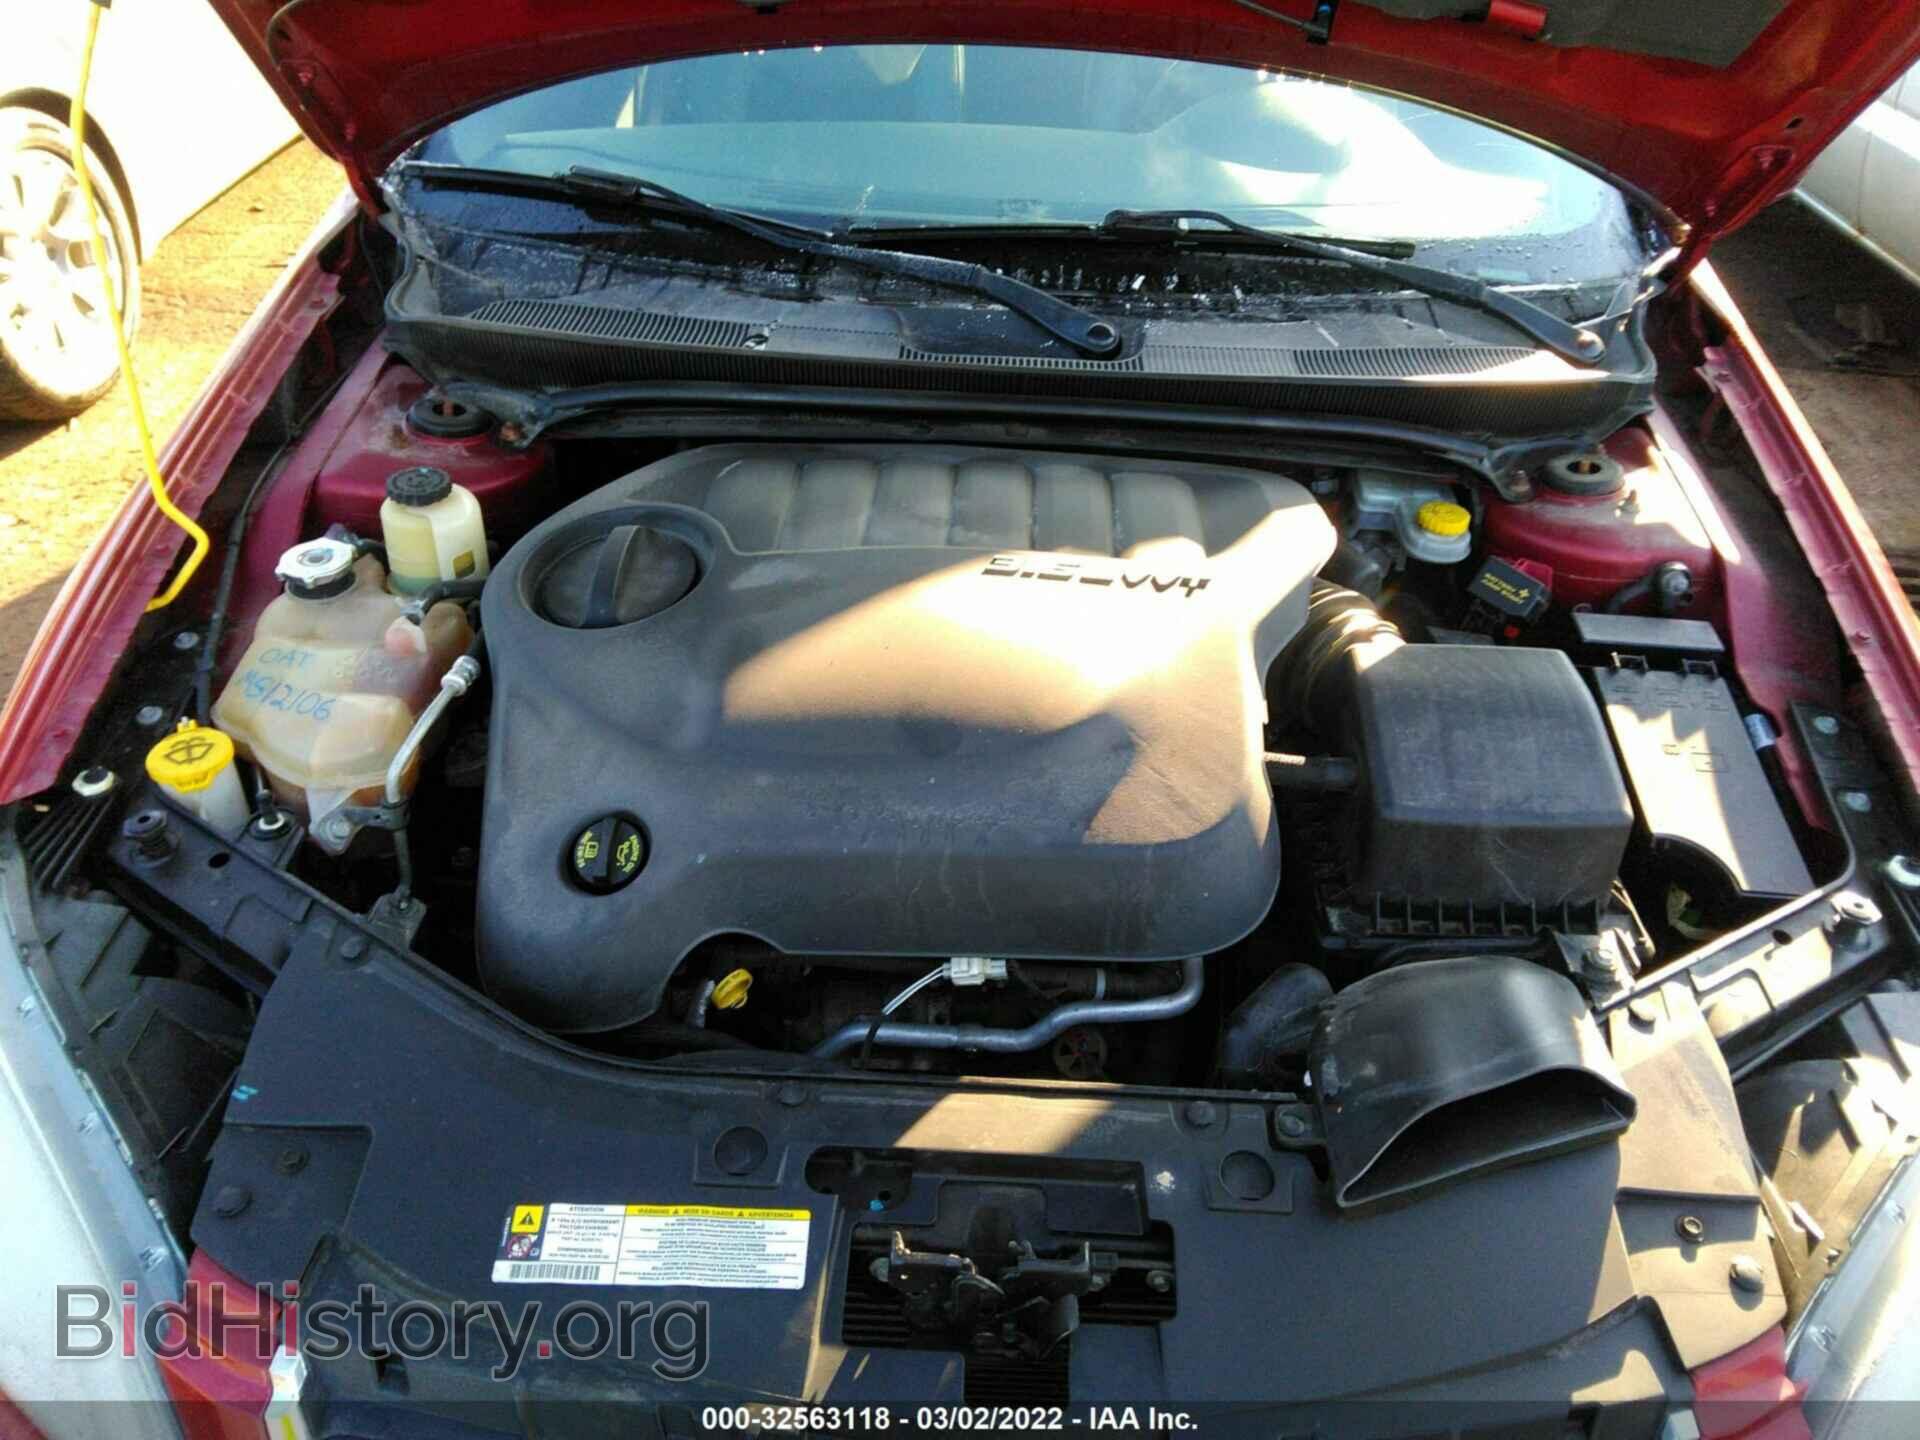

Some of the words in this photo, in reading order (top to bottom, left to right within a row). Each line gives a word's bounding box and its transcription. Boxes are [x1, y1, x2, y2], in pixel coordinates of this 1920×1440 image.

[258, 647, 315, 669] OAT
[629, 834, 640, 862] ENGINE
[622, 862, 635, 873] OIL
